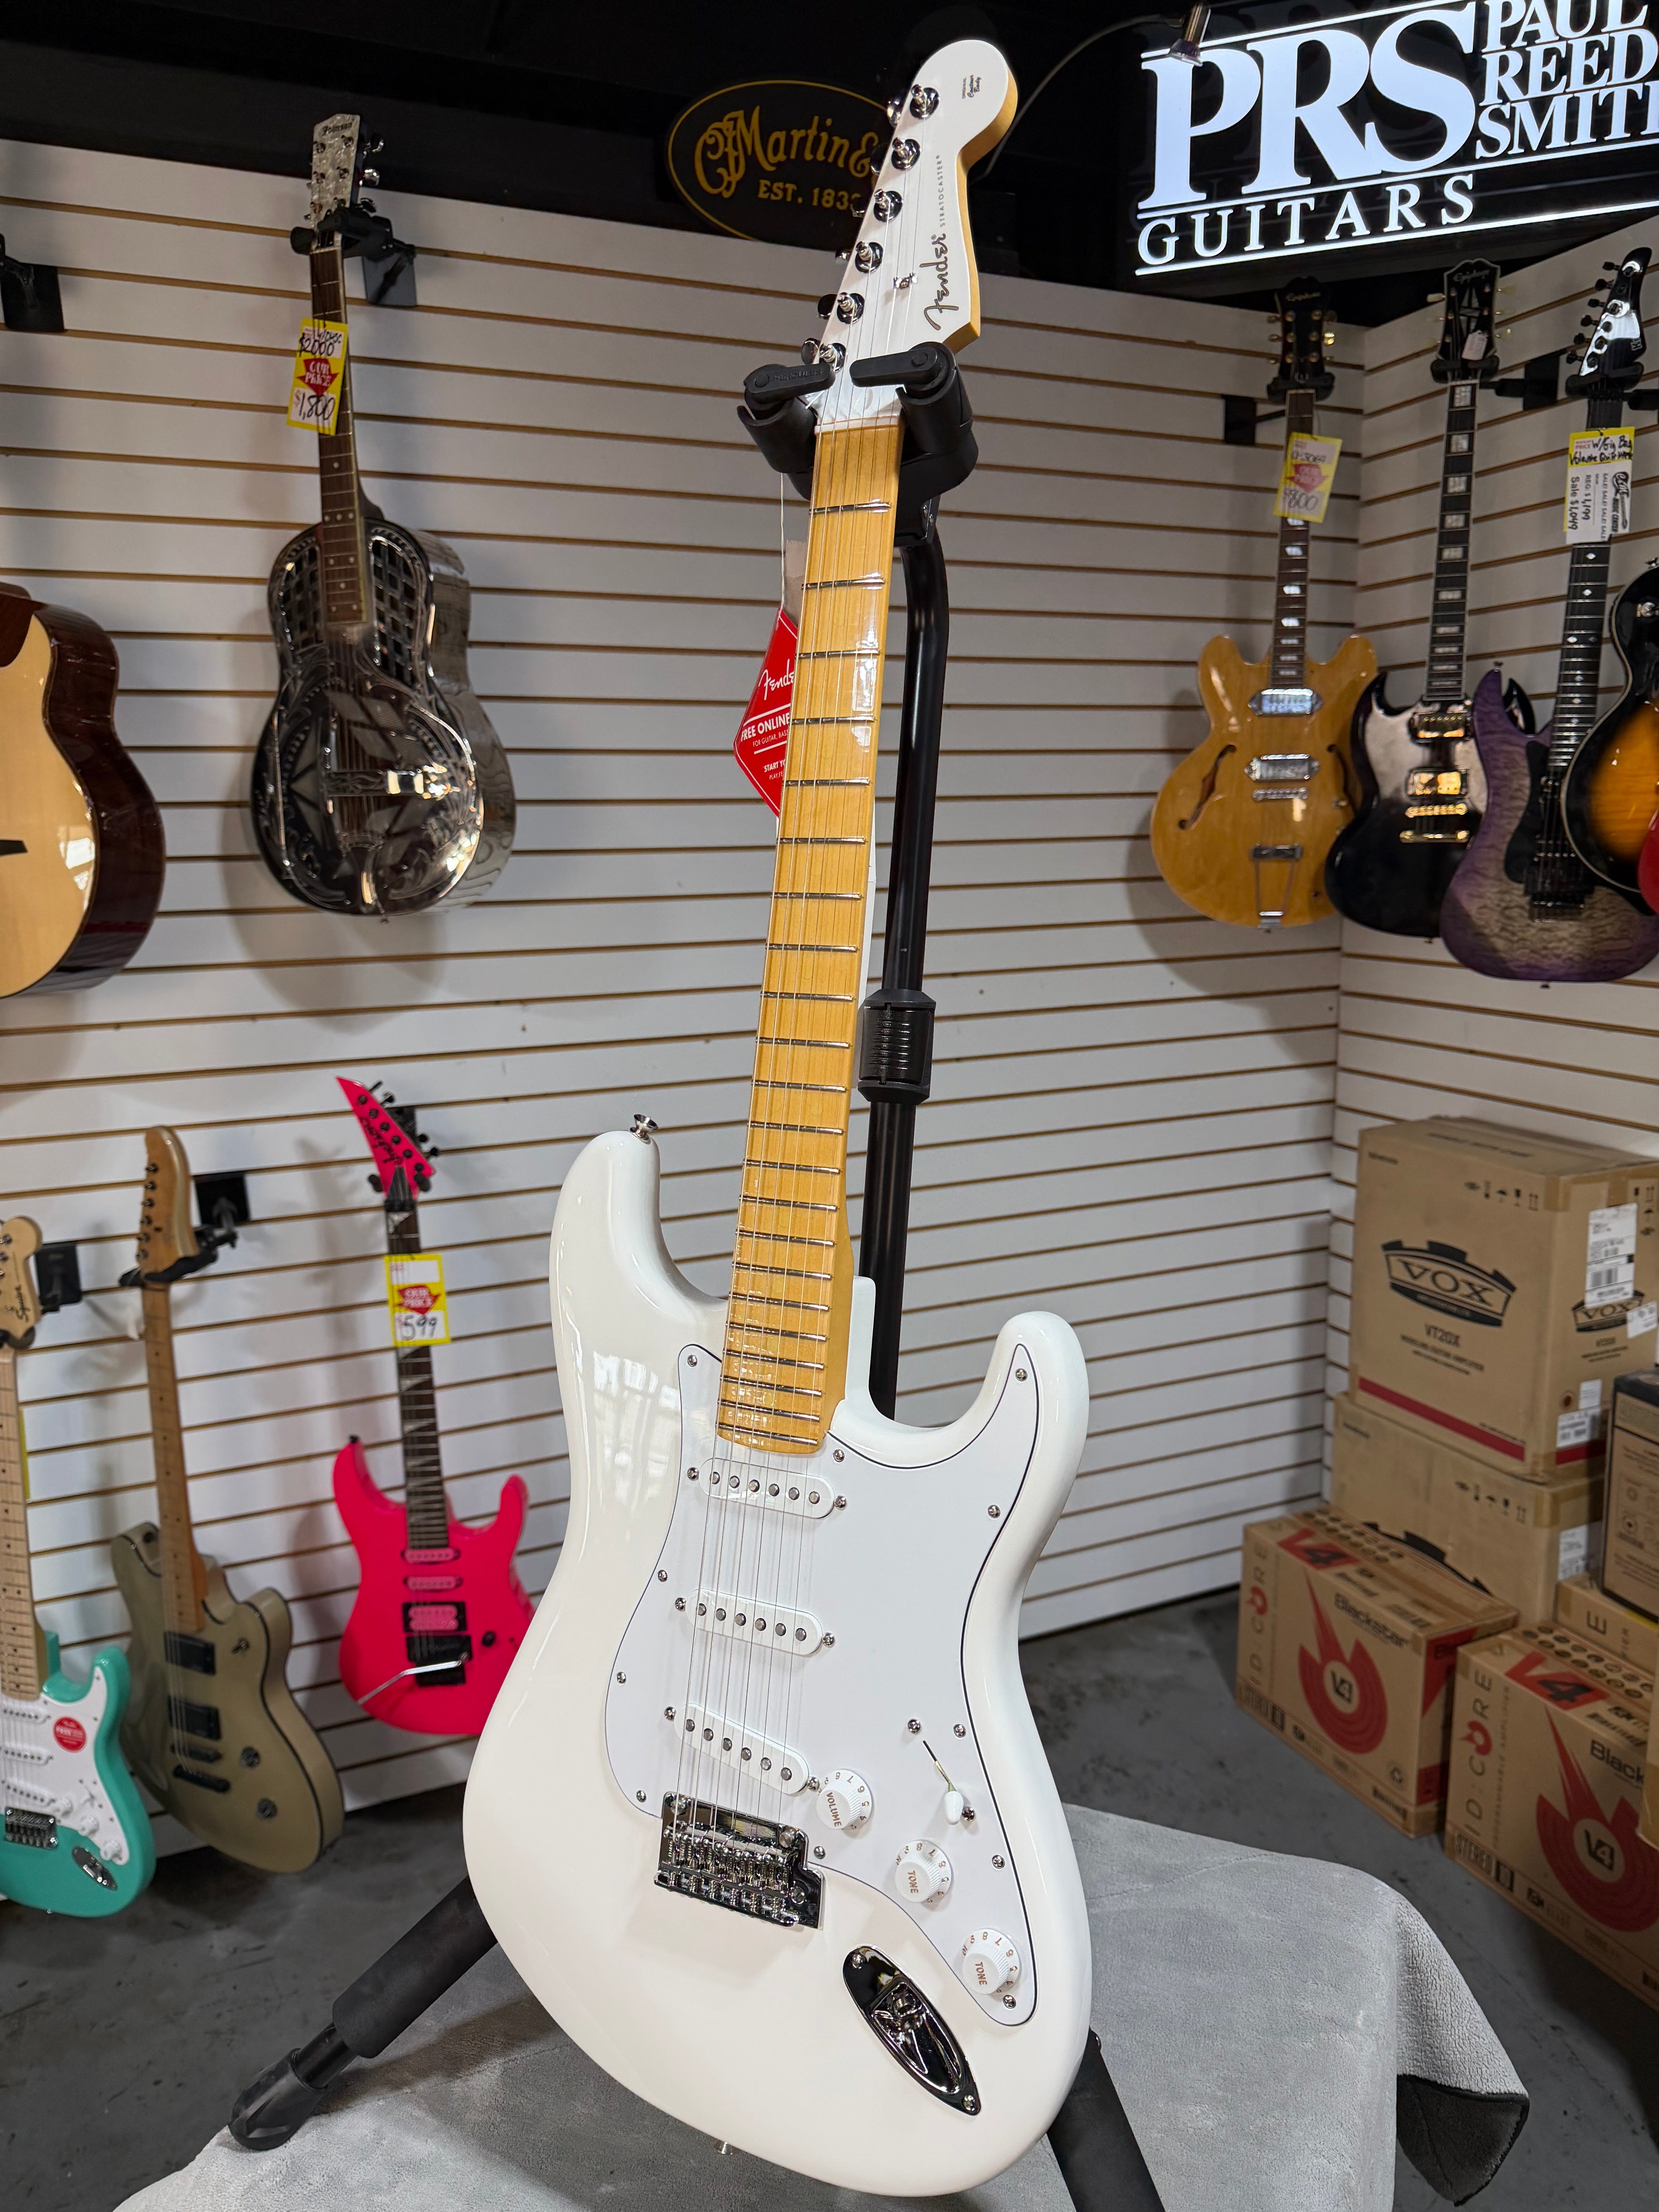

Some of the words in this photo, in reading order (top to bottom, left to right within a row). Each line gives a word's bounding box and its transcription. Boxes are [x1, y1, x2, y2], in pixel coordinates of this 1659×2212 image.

[1482, 0, 1648, 52] PAUL
[1479, 29, 1659, 106] REED
[1137, 0, 1476, 209] PRS
[723, 105, 851, 182] Martin
[758, 179, 804, 204] EST.
[1137, 173, 1474, 266] GUITARS
[919, 233, 960, 331] Fender
[305, 372, 331, 386] PRICE
[309, 361, 330, 375] OUR
[1571, 476, 1580, 497] Sale
[758, 658, 794, 701] Fende
[741, 725, 756, 742] FREE
[757, 712, 790, 735] ONLINE
[764, 761, 779, 773] START
[1398, 1260, 1496, 1308] VOX
[1334, 1592, 1410, 1649] Blackstar
[835, 1772, 841, 1780] 8
[1590, 1739, 1644, 1783] Black
[826, 1792, 842, 1827] VOLUME
[916, 1842, 922, 1851] 8
[907, 1870, 919, 1894] TONE
[982, 1931, 988, 1941] 8
[975, 1961, 988, 1985] TONE
